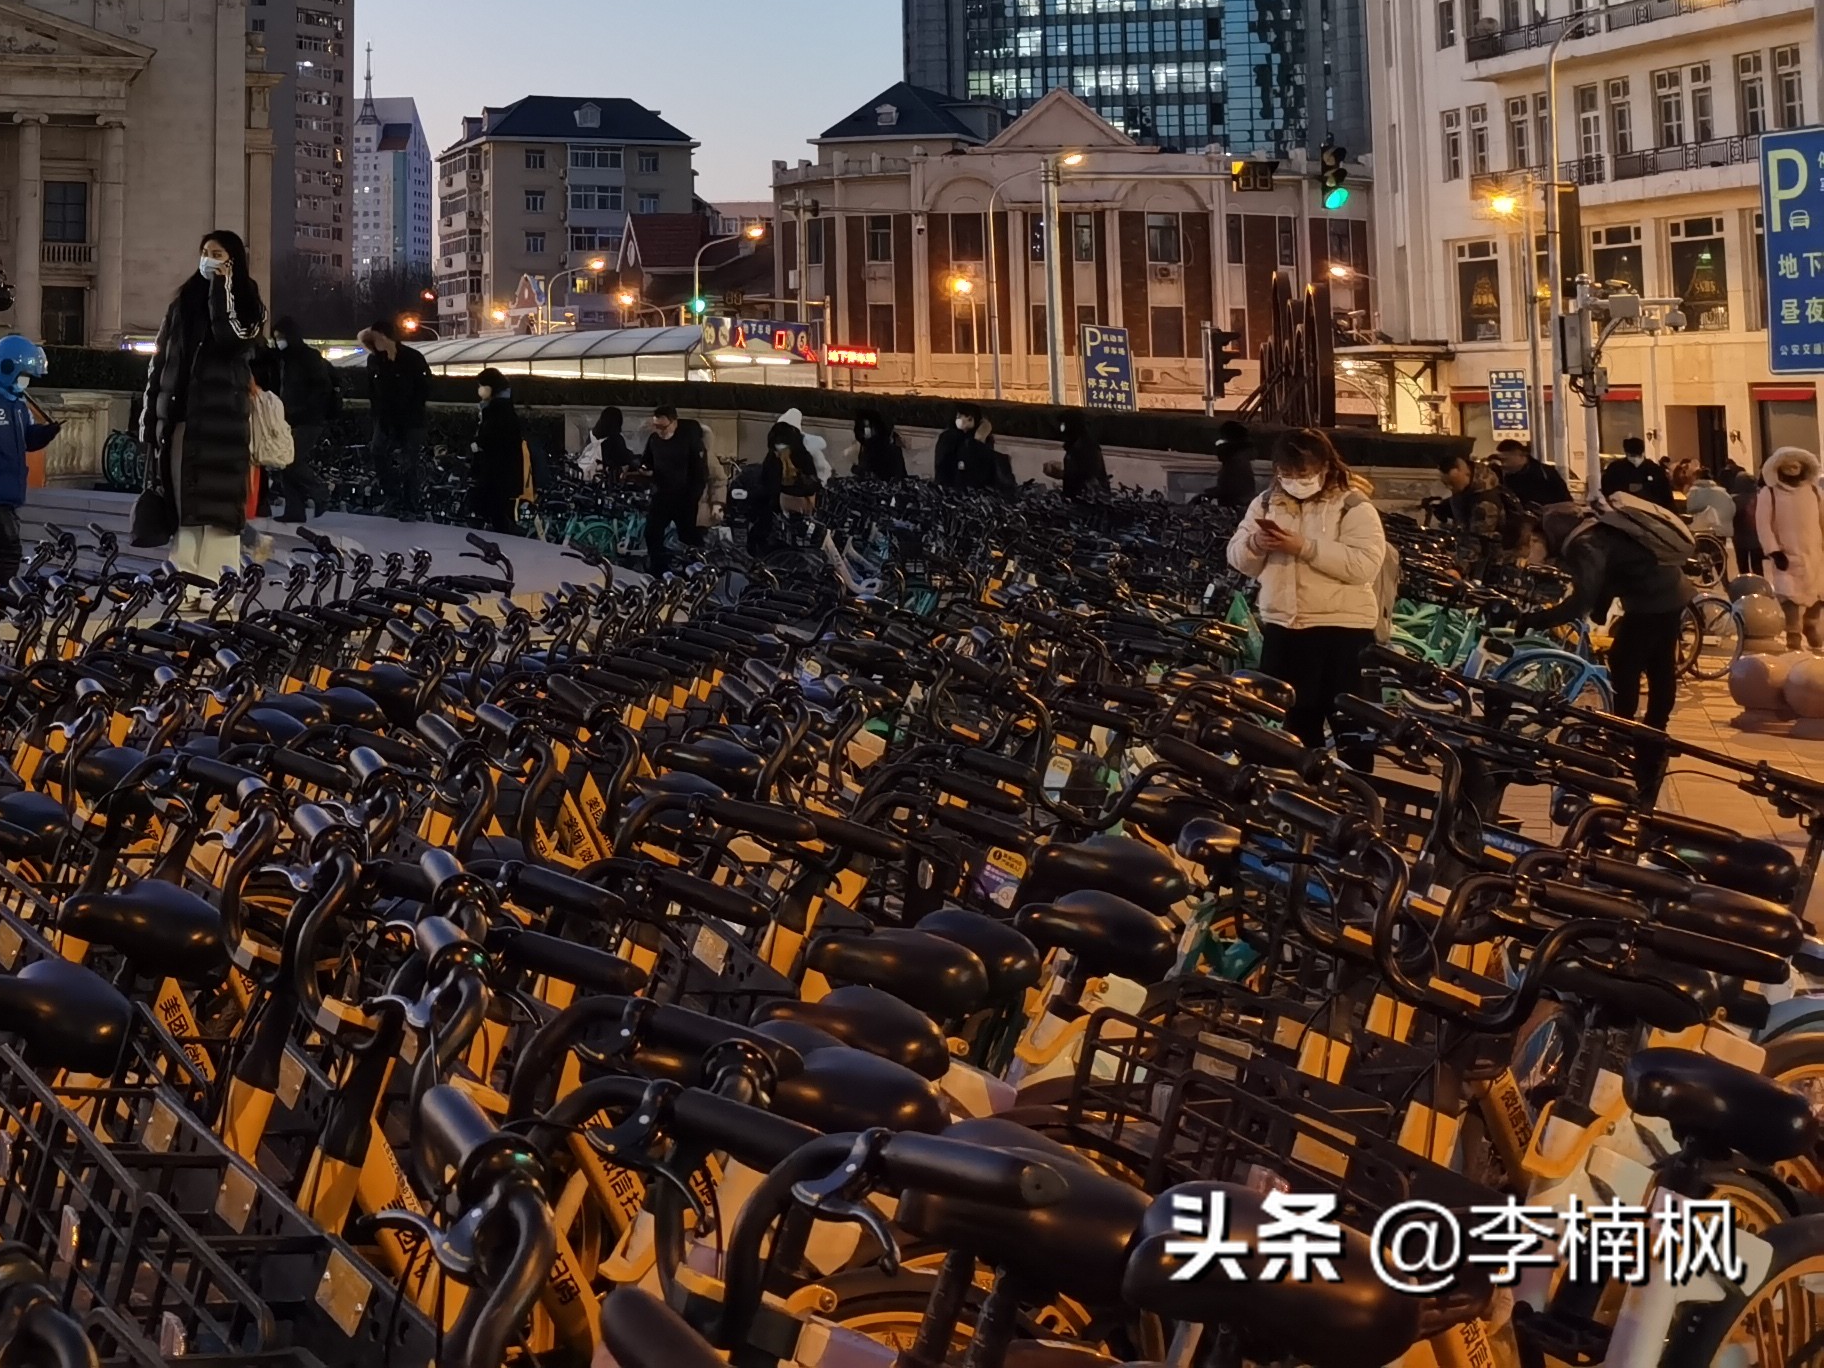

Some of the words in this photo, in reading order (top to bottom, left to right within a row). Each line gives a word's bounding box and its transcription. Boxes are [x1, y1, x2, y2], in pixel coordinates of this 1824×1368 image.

[1768, 148, 1808, 233] P
[1780, 296, 1824, 325] 昼夜
[1085, 327, 1102, 357] P
[1087, 377, 1130, 391] 停车入位
[1092, 390, 1127, 403] 24小时
[563, 817, 586, 846] 美团
[159, 994, 190, 1037] 美团
